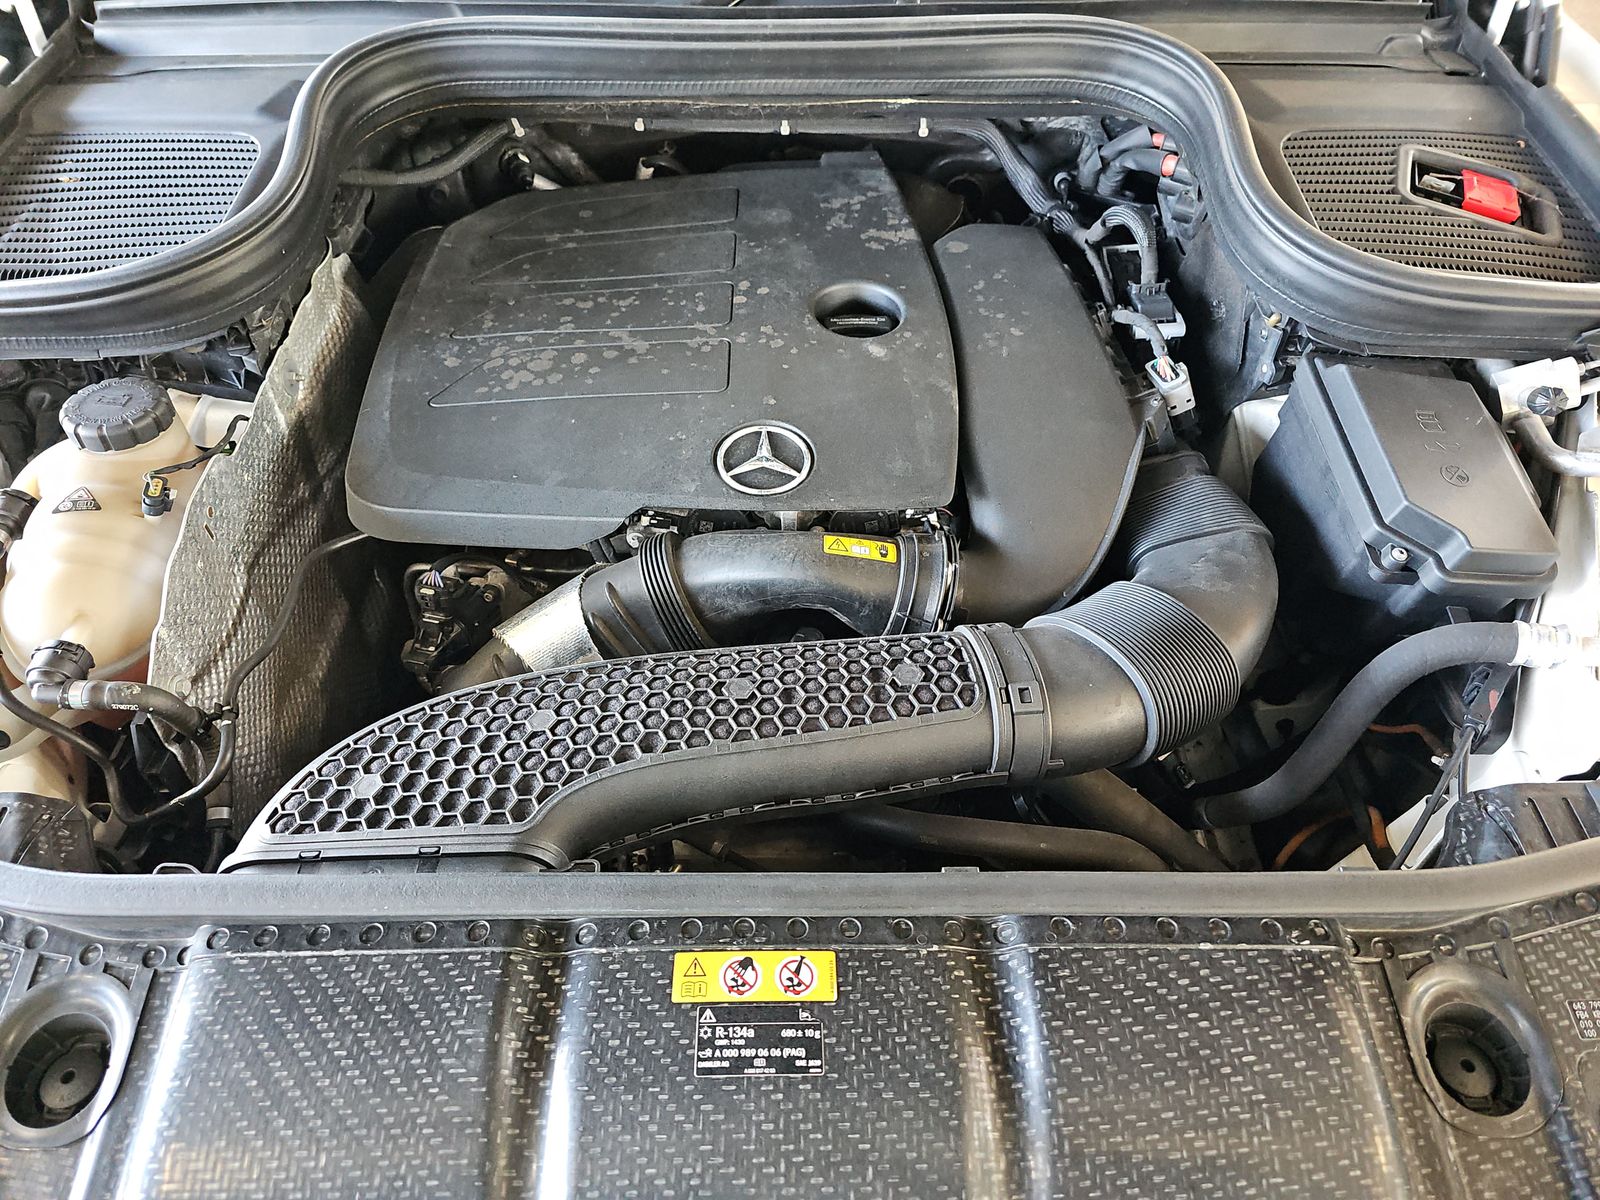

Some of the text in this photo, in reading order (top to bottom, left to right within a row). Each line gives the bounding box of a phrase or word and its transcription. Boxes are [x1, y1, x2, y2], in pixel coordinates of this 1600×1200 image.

[715, 1026, 755, 1039] R-134a
[1584, 1029, 1597, 1037] 100
[714, 1047, 806, 1059] A 000 989 06 06 (PAG)
